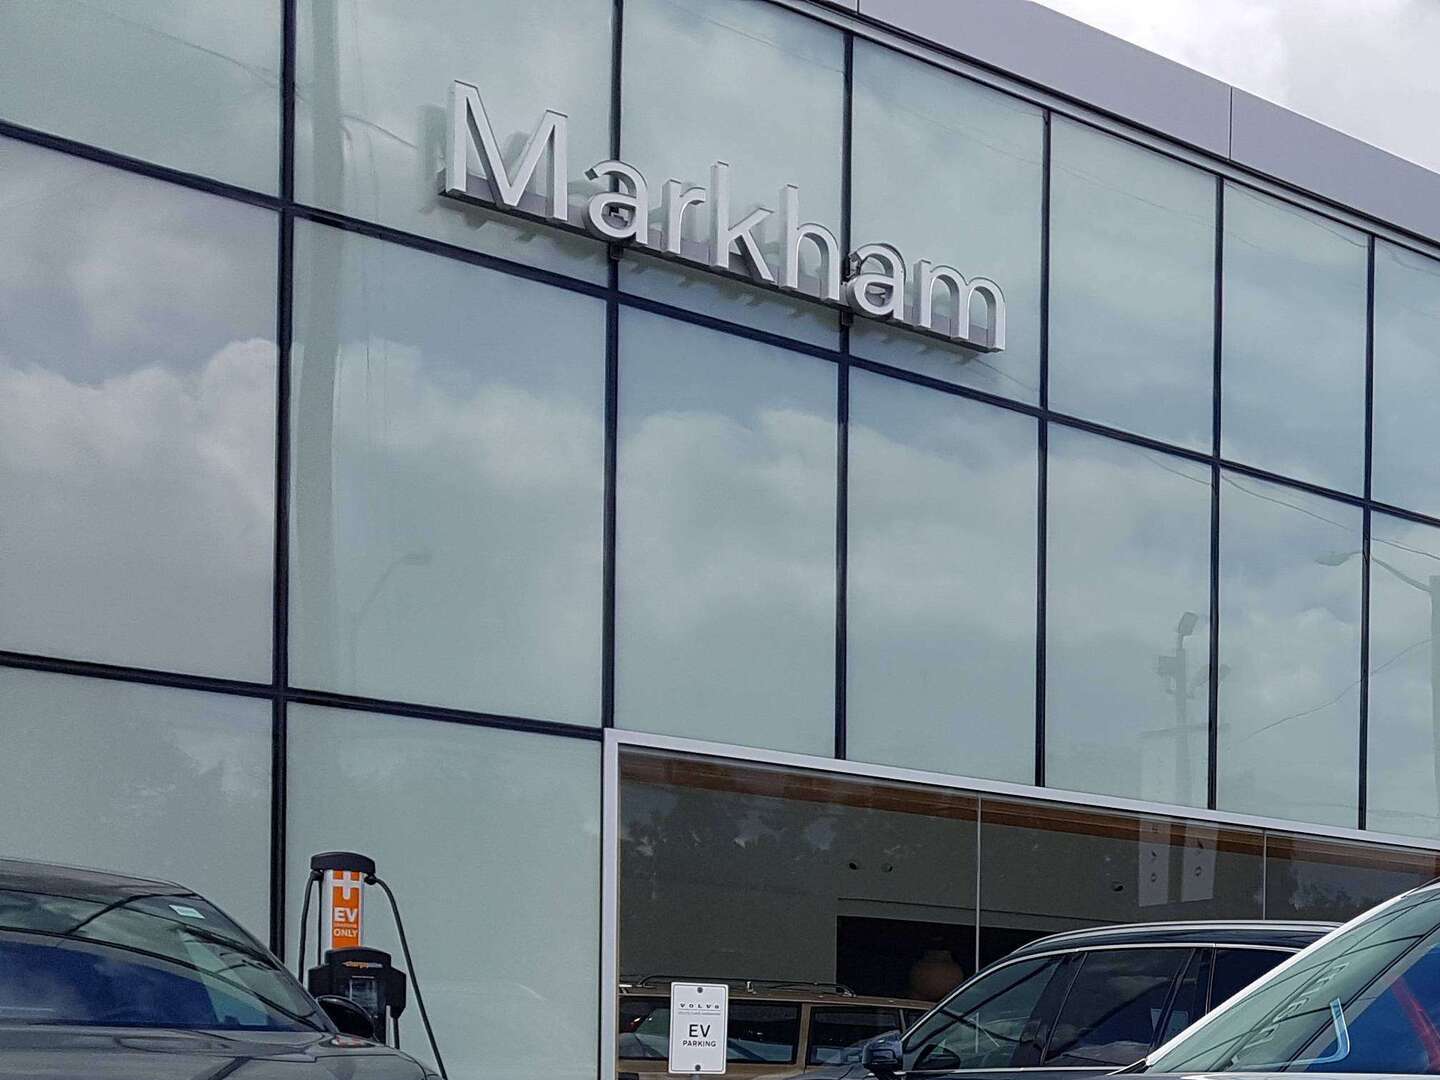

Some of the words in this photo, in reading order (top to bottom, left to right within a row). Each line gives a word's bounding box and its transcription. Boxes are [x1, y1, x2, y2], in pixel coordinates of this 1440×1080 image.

[445, 80, 1006, 353] Markham
[334, 907, 357, 922] EV
[333, 929, 358, 937] ONLY
[689, 1024, 711, 1038] EV
